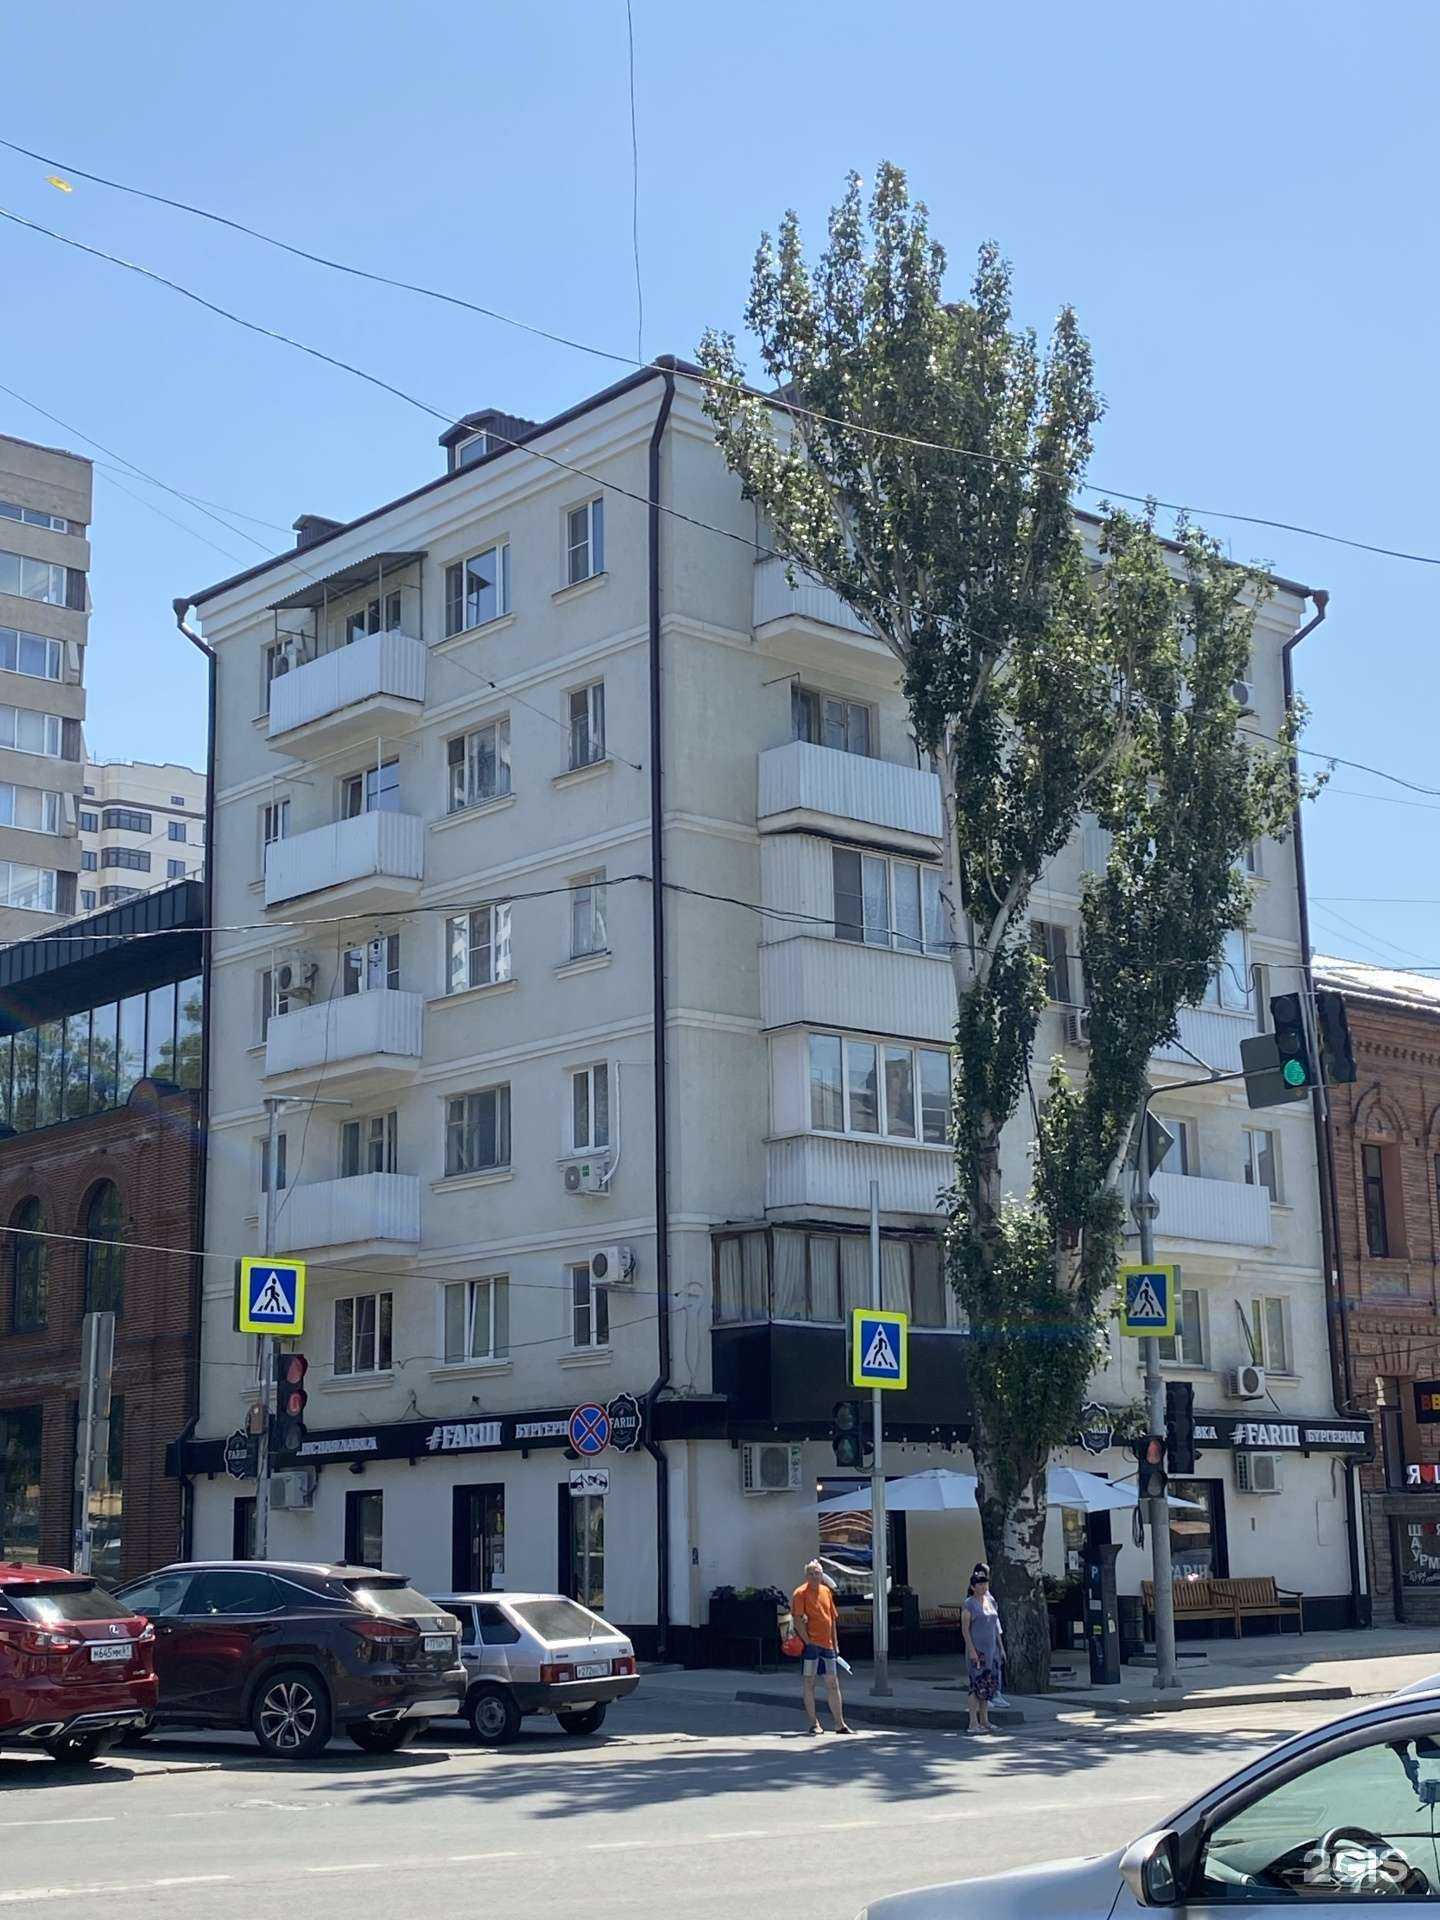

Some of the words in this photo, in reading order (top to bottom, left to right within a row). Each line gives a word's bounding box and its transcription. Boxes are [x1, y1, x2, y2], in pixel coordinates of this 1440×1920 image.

[515, 1420, 570, 1439] БУРГЕРН
[609, 1416, 636, 1428] FARШ
[425, 1421, 503, 1450] #FARШ
[1193, 1426, 1218, 1439] ВКА
[1228, 1423, 1301, 1446] #FARШ
[1305, 1429, 1366, 1444] БУРГЕРНАЯ
